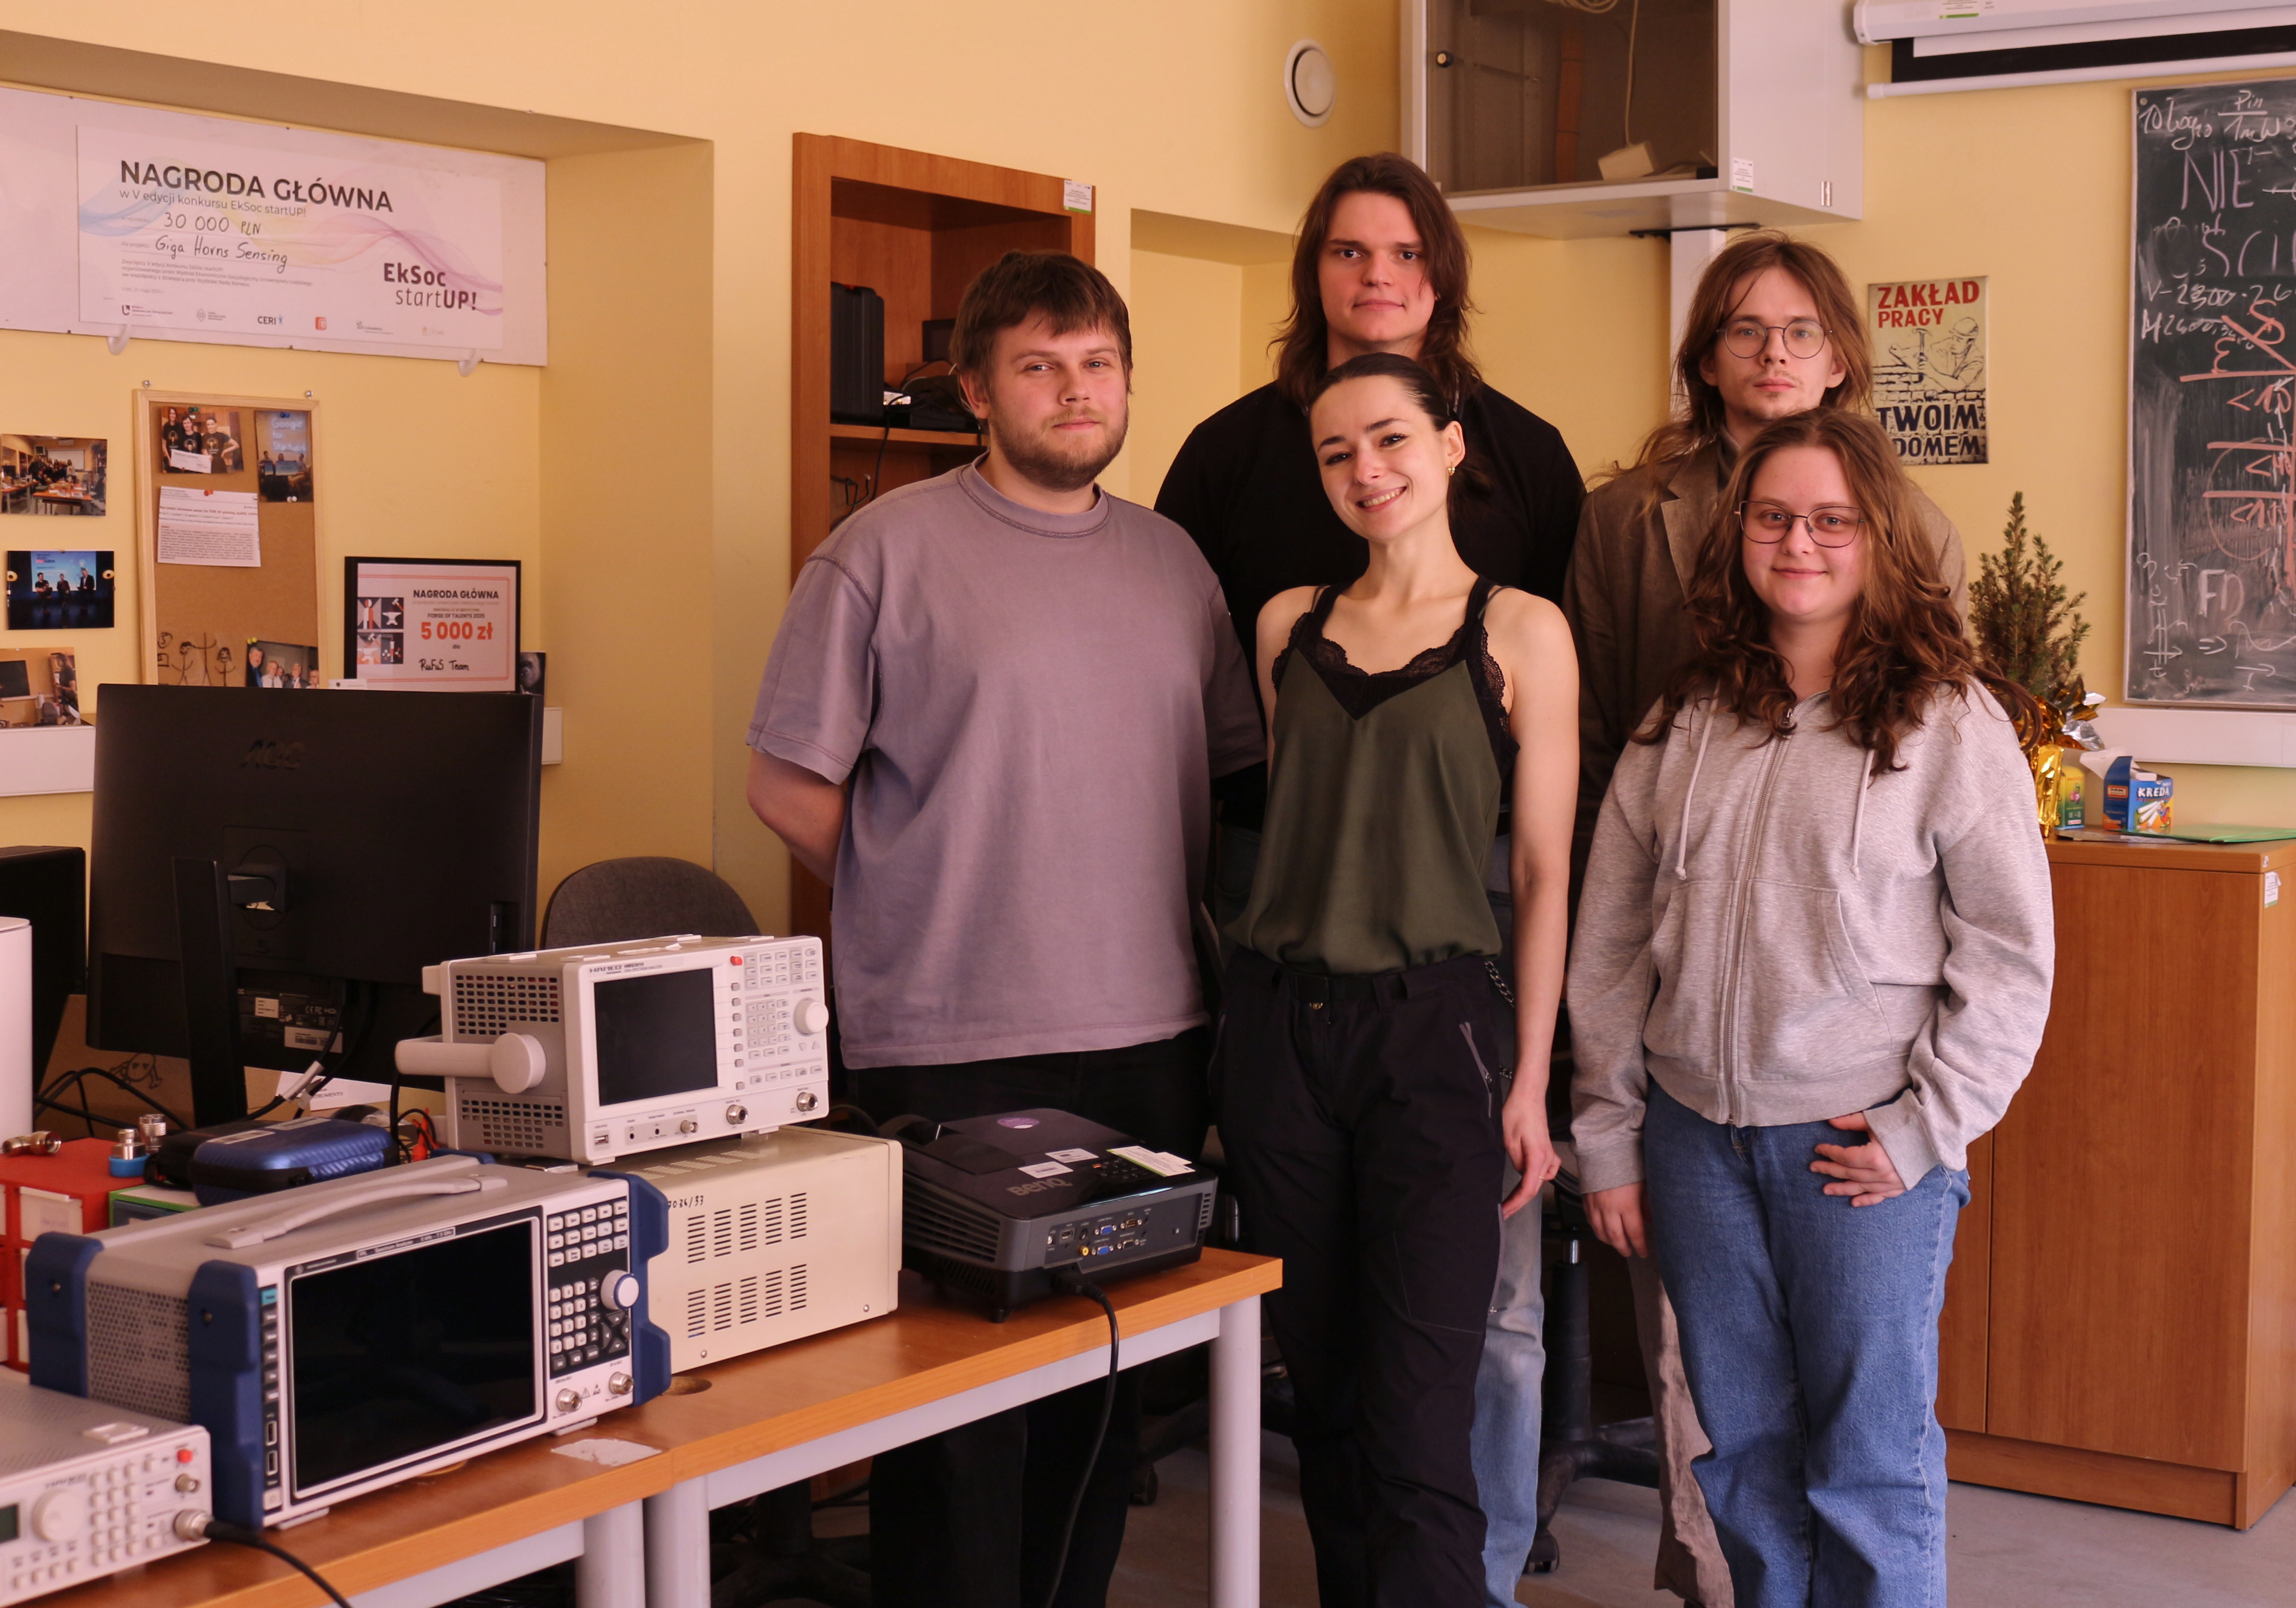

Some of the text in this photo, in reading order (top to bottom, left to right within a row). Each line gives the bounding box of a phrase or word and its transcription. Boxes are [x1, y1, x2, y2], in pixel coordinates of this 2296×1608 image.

[122, 161, 393, 212] NAGRODA GŁÓWNA
[120, 190, 306, 217] w V edycji konkursu EkSoc startUP!
[164, 212, 186, 229] 30
[195, 216, 229, 232] 000
[241, 221, 261, 235] PLN
[156, 235, 288, 274] Giga Horns Sensing
[384, 262, 446, 286] EkSoc
[395, 288, 477, 310] startUP!
[1878, 281, 1980, 309] ZAKŁAD
[258, 316, 276, 325] CERI
[1878, 308, 1944, 328] PRACY
[1876, 404, 1980, 432] TWOIM
[1892, 436, 1981, 457] DOMEM
[413, 588, 499, 599] NAGRODA GŁÓWNA
[421, 622, 493, 640] 5 000 zł
[448, 660, 469, 671] Team
[2137, 787, 2169, 797] KREDA
[1007, 1178, 1073, 1196] BenQ
